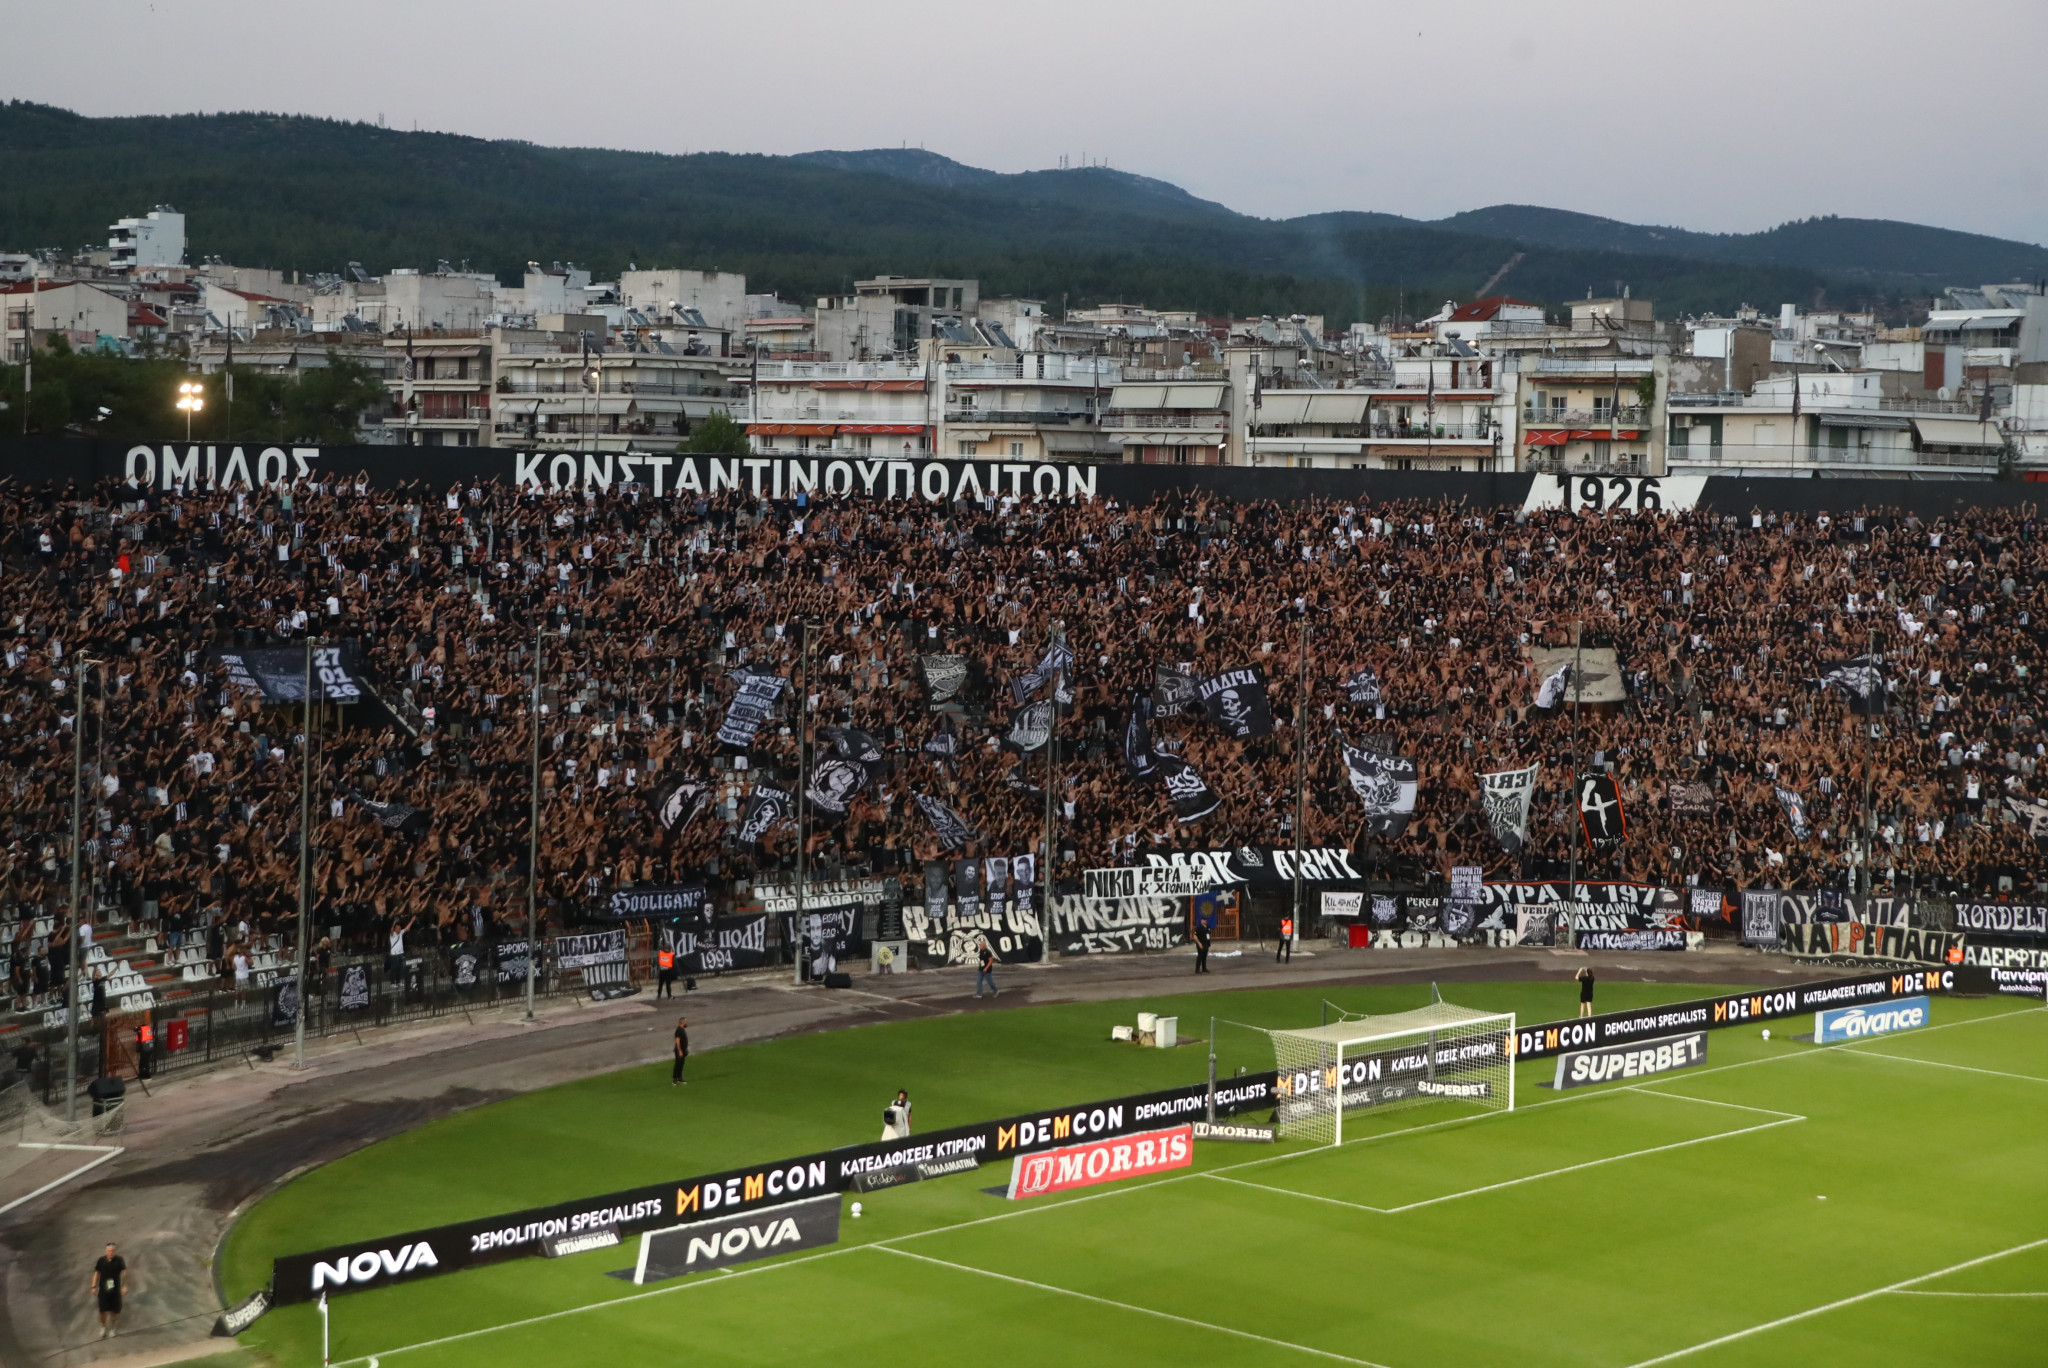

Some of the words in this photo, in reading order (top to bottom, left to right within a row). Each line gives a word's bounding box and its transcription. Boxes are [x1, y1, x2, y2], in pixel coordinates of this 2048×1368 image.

[124, 445, 320, 493] ΟΜΙΛΟΣ
[1557, 475, 1662, 514] 1926
[314, 648, 341, 667] 27
[319, 667, 353, 684] 01
[325, 683, 361, 697] 26
[1581, 780, 1618, 837] 4
[1672, 803, 1710, 813] LAGADAS
[1272, 847, 1363, 881] ARMY
[1406, 896, 1439, 908] PEREA
[1602, 884, 1657, 906] 197
[700, 949, 734, 970] 1994
[927, 939, 946, 956] 20
[1803, 983, 1856, 1004] ΚΑΤΕΔΑΦΙΣΕΙΣ
[1856, 980, 1887, 996] ΚΤΙΡΙΩΝ
[1998, 983, 2044, 994] AutoMobility
[1604, 1017, 1657, 1037] DEMOLITION
[1657, 1007, 1708, 1028] SPECIALISTS
[1845, 1006, 1924, 1037] avance
[1391, 1047, 1459, 1072] ΚΑΤΕΔΑΙΣΕΙΣ
[1571, 1033, 1701, 1082] SUPERBET
[1417, 1080, 1487, 1097] SUPERBET
[1135, 1094, 1203, 1121] DEMOLITION
[1209, 1124, 1274, 1140] MORRIS
[841, 1144, 934, 1178] ΚΑΤΕΔΑΦΙΣΕΙΣ
[936, 1133, 986, 1159] ΚΤΙΡΙΩΝ
[928, 1156, 979, 1176] ΜΑΛΑΜΑΤΙΝΑ
[1055, 1132, 1189, 1184] MORRIS
[470, 1216, 568, 1253] DEMOLITION
[570, 1198, 663, 1232] SPECIALISTS
[686, 1216, 802, 1265] NOVA
[310, 1240, 439, 1291] NOVA
[225, 1291, 268, 1329] SUPERBET
